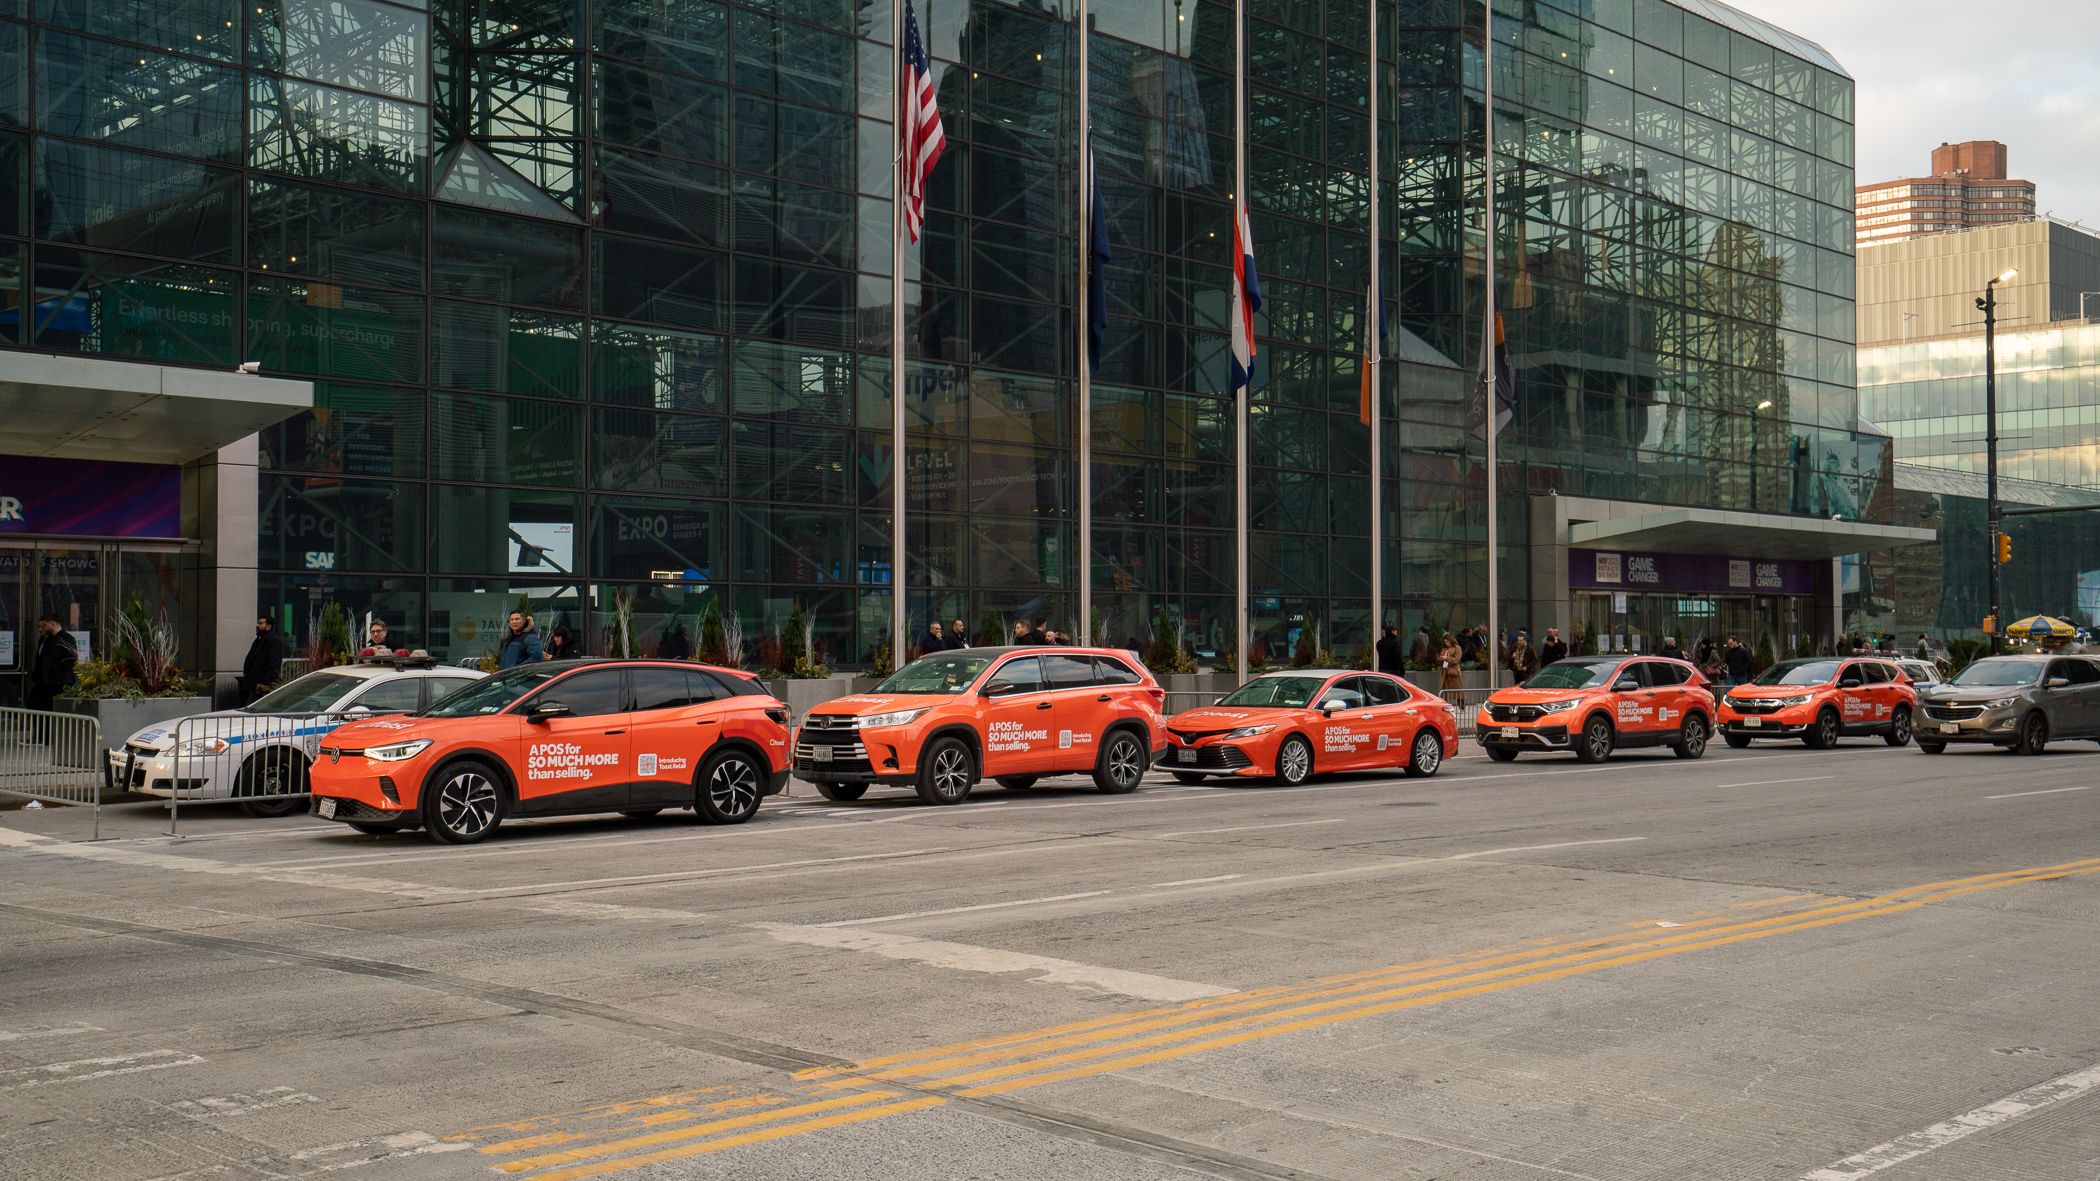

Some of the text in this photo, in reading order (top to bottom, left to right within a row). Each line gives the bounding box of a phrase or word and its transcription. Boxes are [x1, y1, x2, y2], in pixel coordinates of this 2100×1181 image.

[618, 515, 668, 541] EXPO
[1628, 557, 1654, 571] GAME
[1756, 563, 1778, 577] GAME
[1628, 571, 1659, 583] CHANGER
[1756, 576, 1782, 588] CHANGER
[989, 721, 1023, 732] A POS for
[1325, 726, 1350, 735] A POS for
[988, 730, 1047, 742] SO MUCH MORE
[1325, 734, 1369, 744] SO MUCH MORE
[529, 742, 582, 756] A POS for
[988, 741, 1031, 752] than selling.
[1325, 743, 1356, 753] than selling.
[528, 753, 619, 768] SO MUCH MORE
[659, 757, 686, 765] Introducing
[528, 766, 593, 780] than selling.
